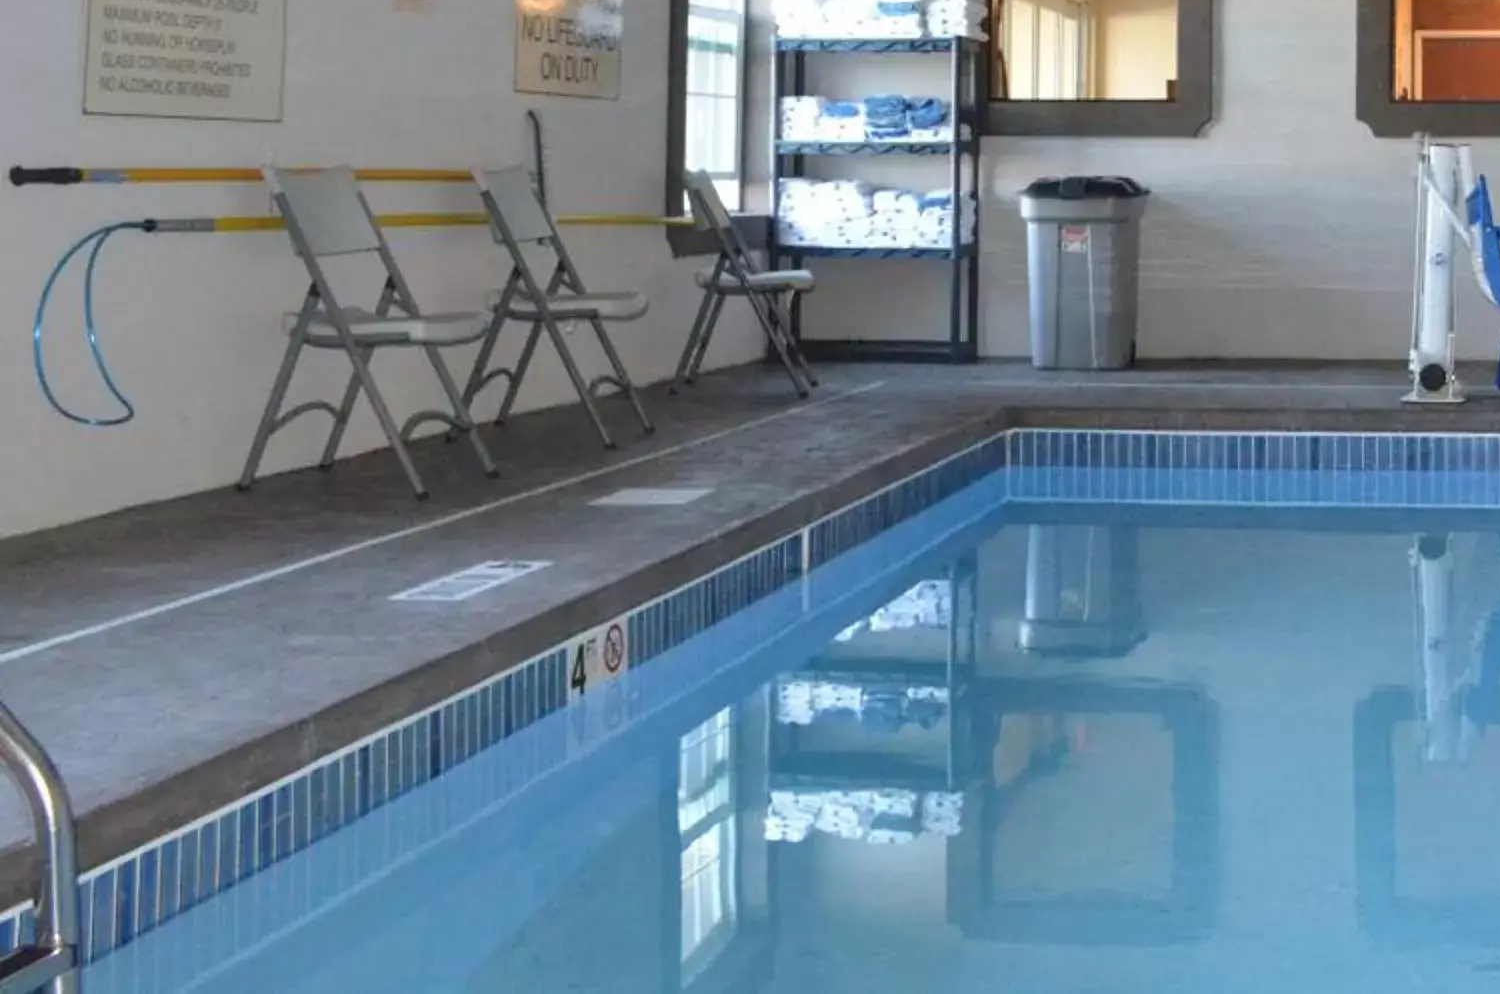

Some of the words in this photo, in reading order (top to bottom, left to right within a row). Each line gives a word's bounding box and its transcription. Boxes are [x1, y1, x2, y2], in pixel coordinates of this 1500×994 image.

[523, 13, 545, 42] NO
[541, 52, 562, 81] ON
[565, 55, 599, 83] DUTY
[571, 643, 586, 694] 4
